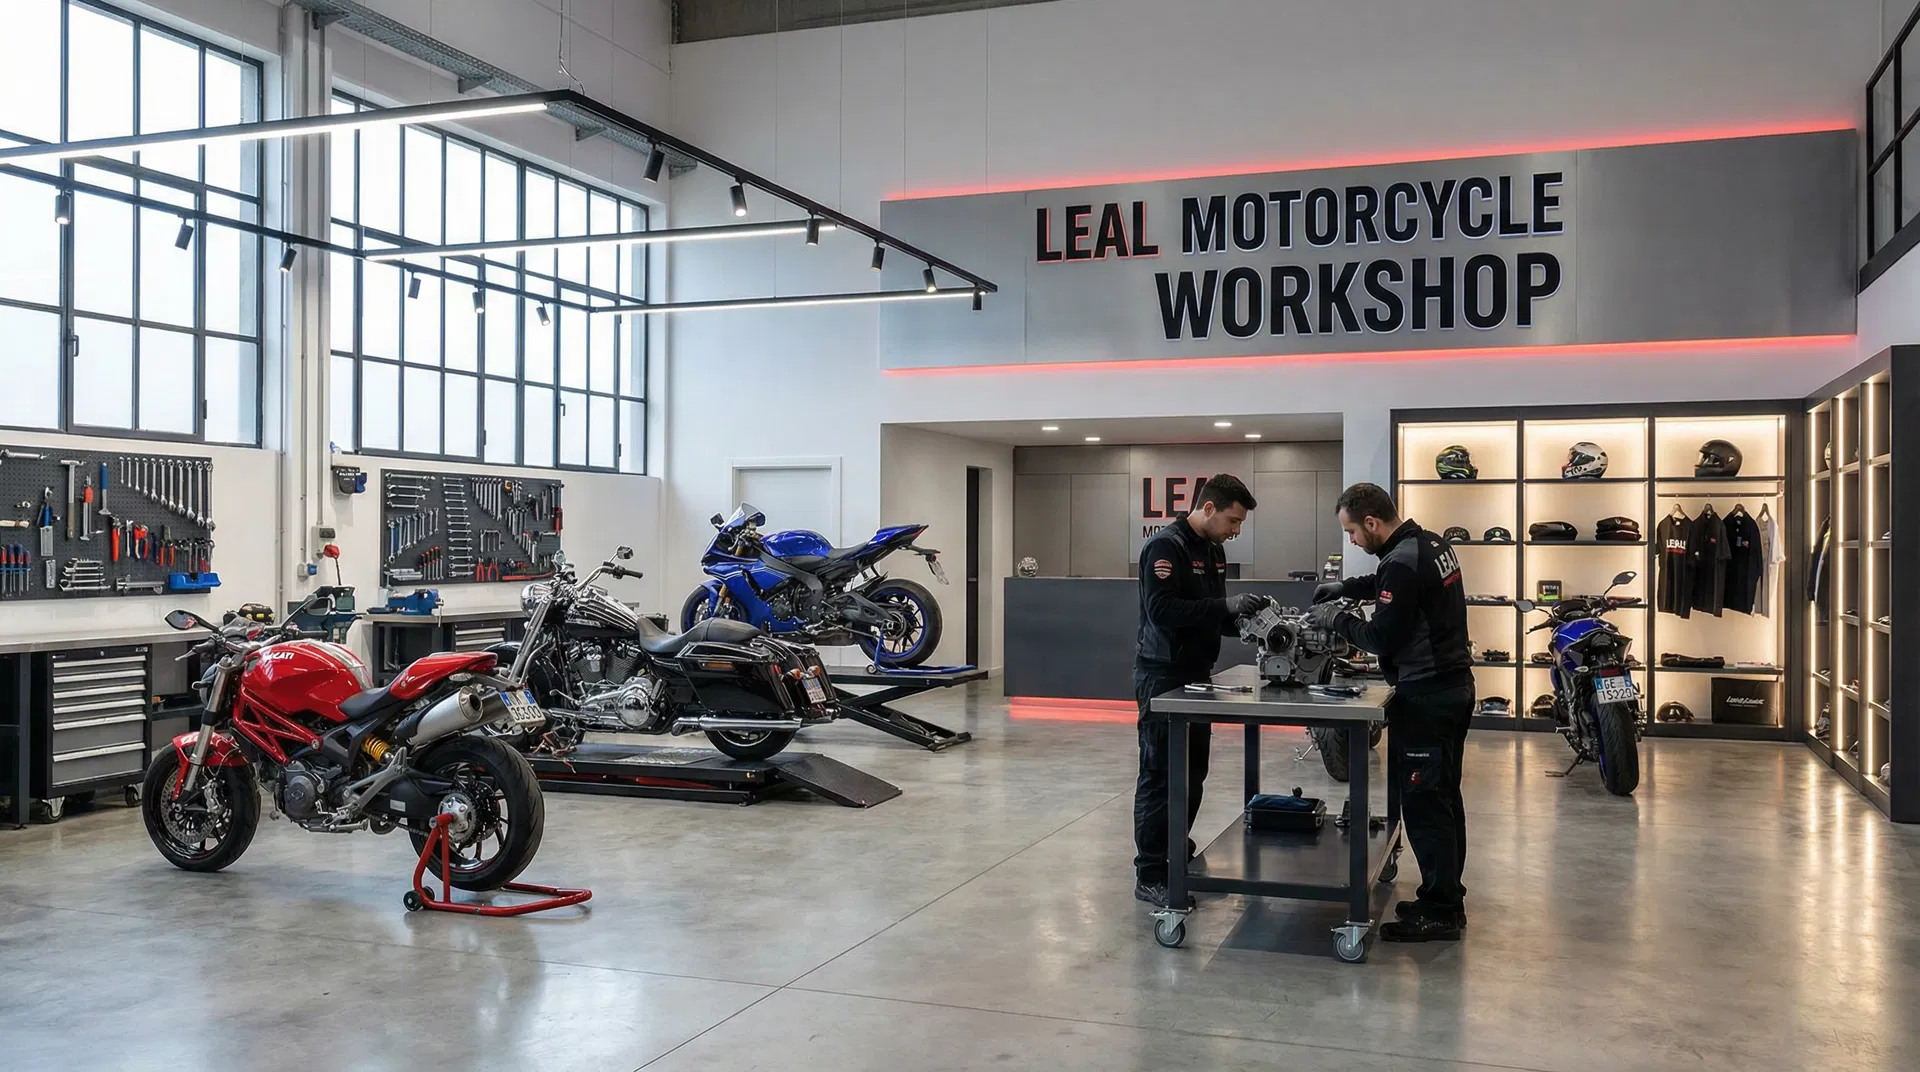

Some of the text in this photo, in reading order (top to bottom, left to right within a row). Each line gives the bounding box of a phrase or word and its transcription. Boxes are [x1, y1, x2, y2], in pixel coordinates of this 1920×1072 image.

[1037, 172, 1563, 262] LEAL MOTORCYCLE
[1154, 252, 1561, 341] WORKSHOP
